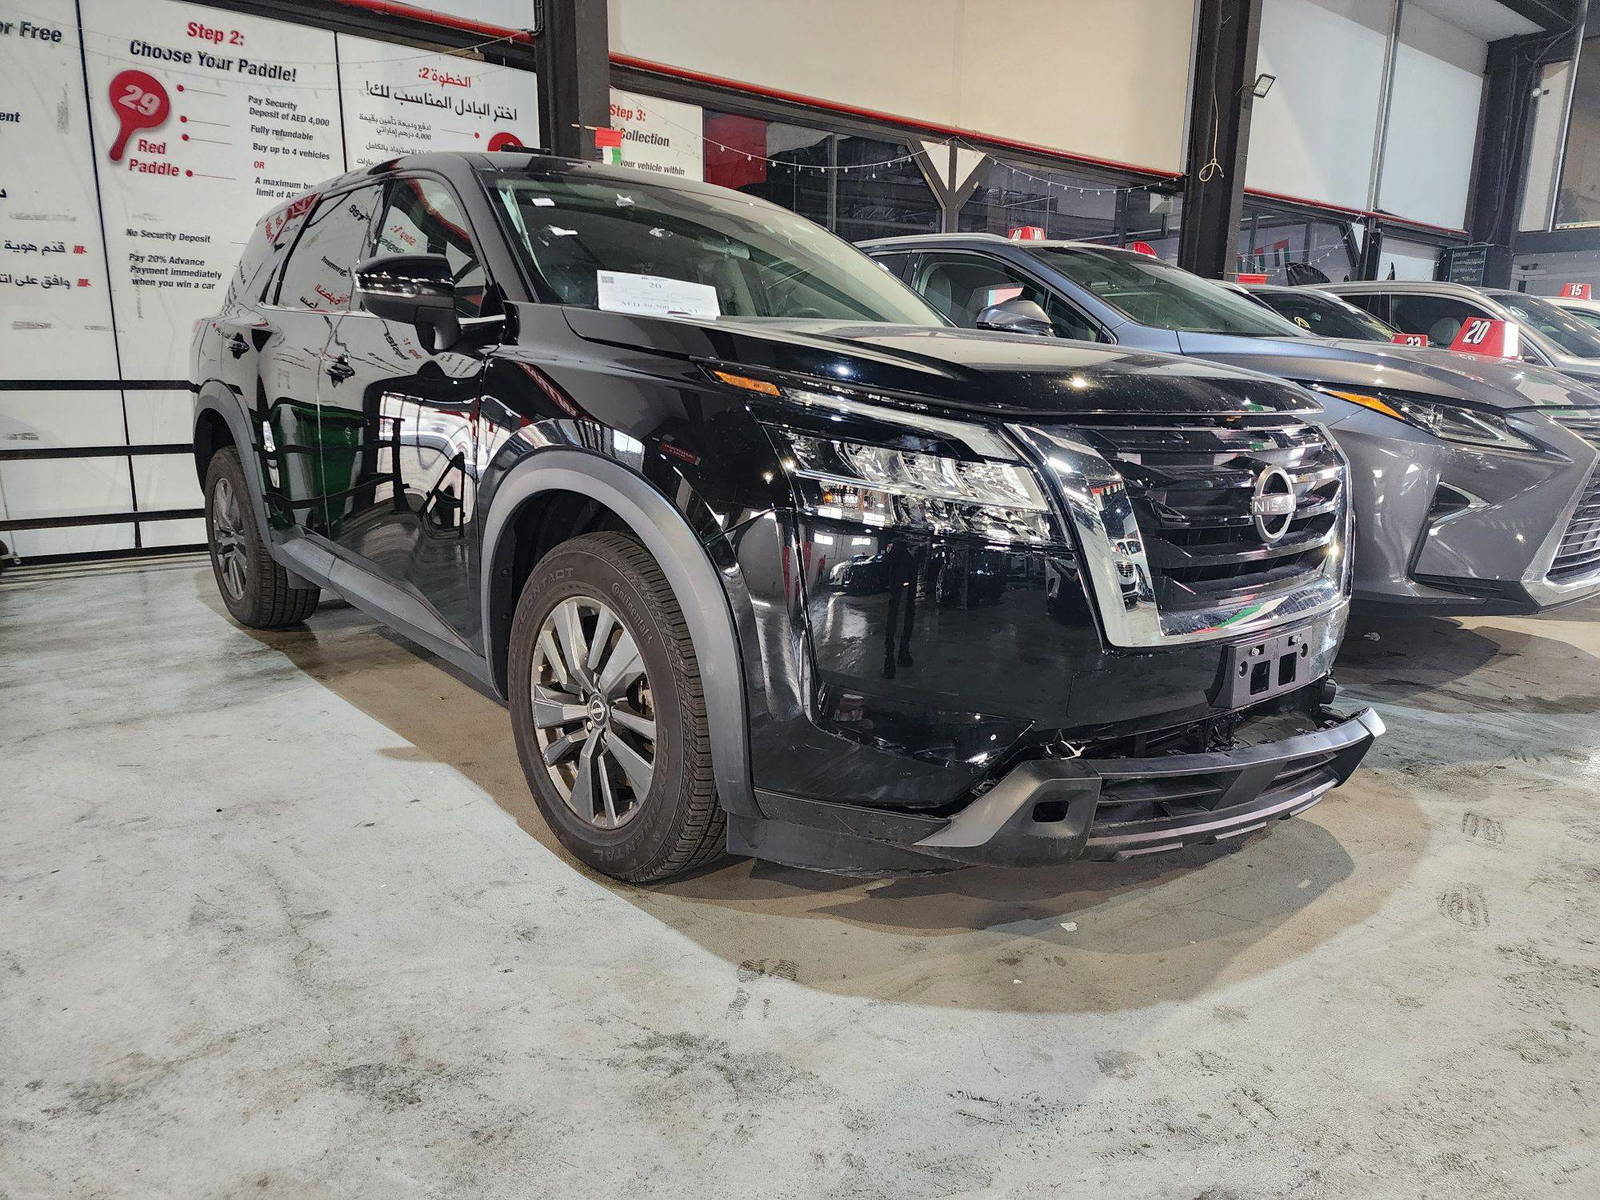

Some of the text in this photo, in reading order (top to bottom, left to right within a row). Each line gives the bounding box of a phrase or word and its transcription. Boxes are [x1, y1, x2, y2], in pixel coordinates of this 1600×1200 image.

[19, 20, 62, 43] Free
[187, 21, 244, 46] Step 2:
[130, 39, 297, 82] Choose Your Paddle!
[431, 68, 471, 88] الخطوة
[118, 84, 161, 116] 29
[248, 95, 297, 111] Pay Security
[394, 92, 451, 109] المناسب
[249, 107, 279, 119] Deposit
[290, 114, 306, 123] AED
[308, 117, 330, 126] 4,000
[454, 99, 490, 119] البادل
[493, 107, 517, 122] اختر
[609, 103, 646, 122] Step 3:
[251, 125, 313, 141] Fully refundable
[620, 127, 670, 147] Collection
[138, 139, 167, 154] Red
[252, 143, 268, 152] Buy
[282, 147, 290, 155] to
[299, 150, 330, 160] vehicles
[128, 158, 180, 176] Paddle
[254, 161, 265, 169] OR
[638, 162, 662, 173] vehicle
[664, 166, 685, 176] within
[255, 176, 261, 184] A
[263, 178, 301, 188] maximum
[256, 188, 275, 196] limit
[126, 228, 211, 243] No Security Deposit
[129, 253, 205, 266] Pay 20% Advance
[130, 265, 222, 280] Payment immediately
[15, 275, 38, 287] على
[131, 278, 156, 286] when
[158, 280, 174, 288] you
[176, 280, 192, 288] win
[202, 282, 216, 290] car
[1570, 284, 1585, 296] 15
[1462, 320, 1491, 345] 20
